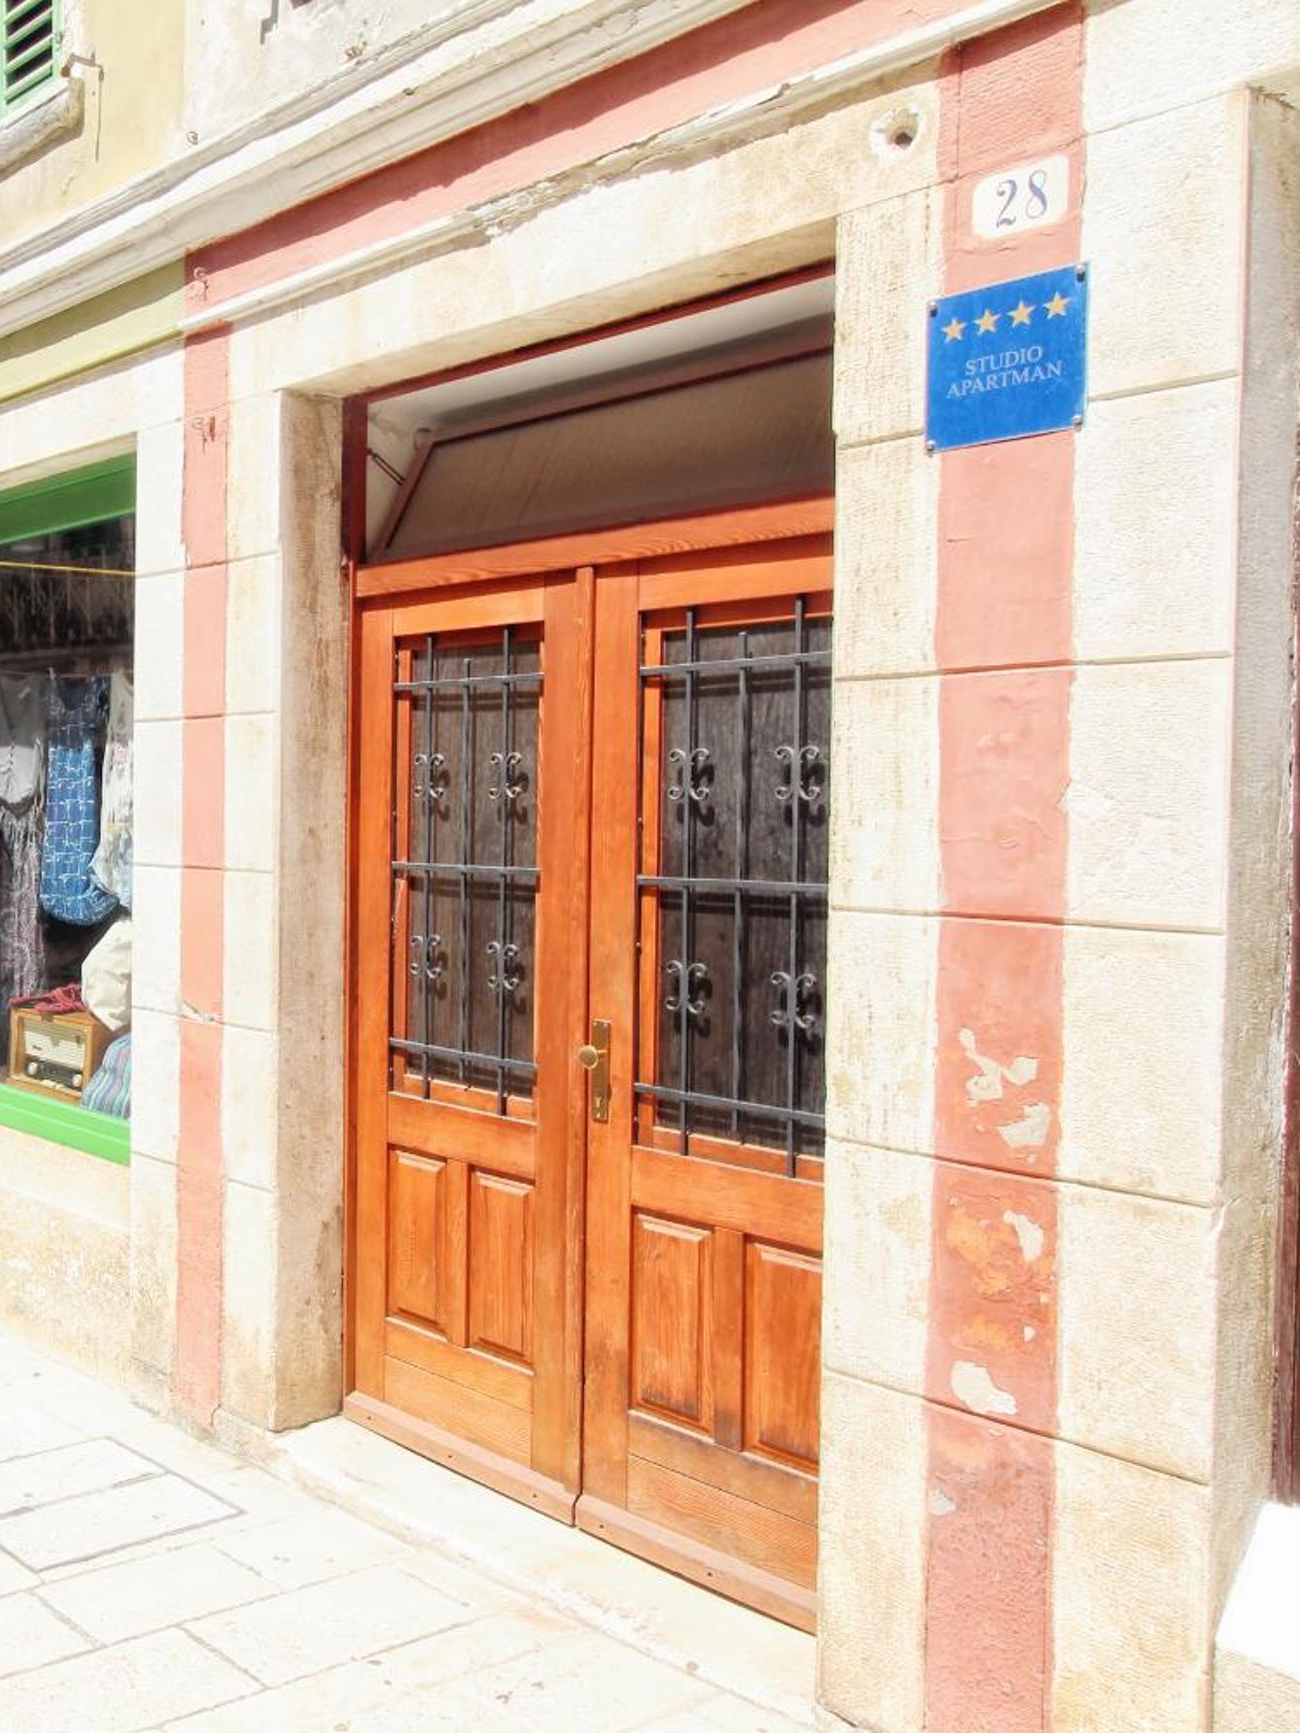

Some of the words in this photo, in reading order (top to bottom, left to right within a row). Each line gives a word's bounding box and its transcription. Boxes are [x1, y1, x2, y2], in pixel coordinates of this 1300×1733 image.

[995, 169, 1049, 229] 28
[964, 345, 1043, 376] STUDIO
[946, 361, 1063, 399] APARTMAN
